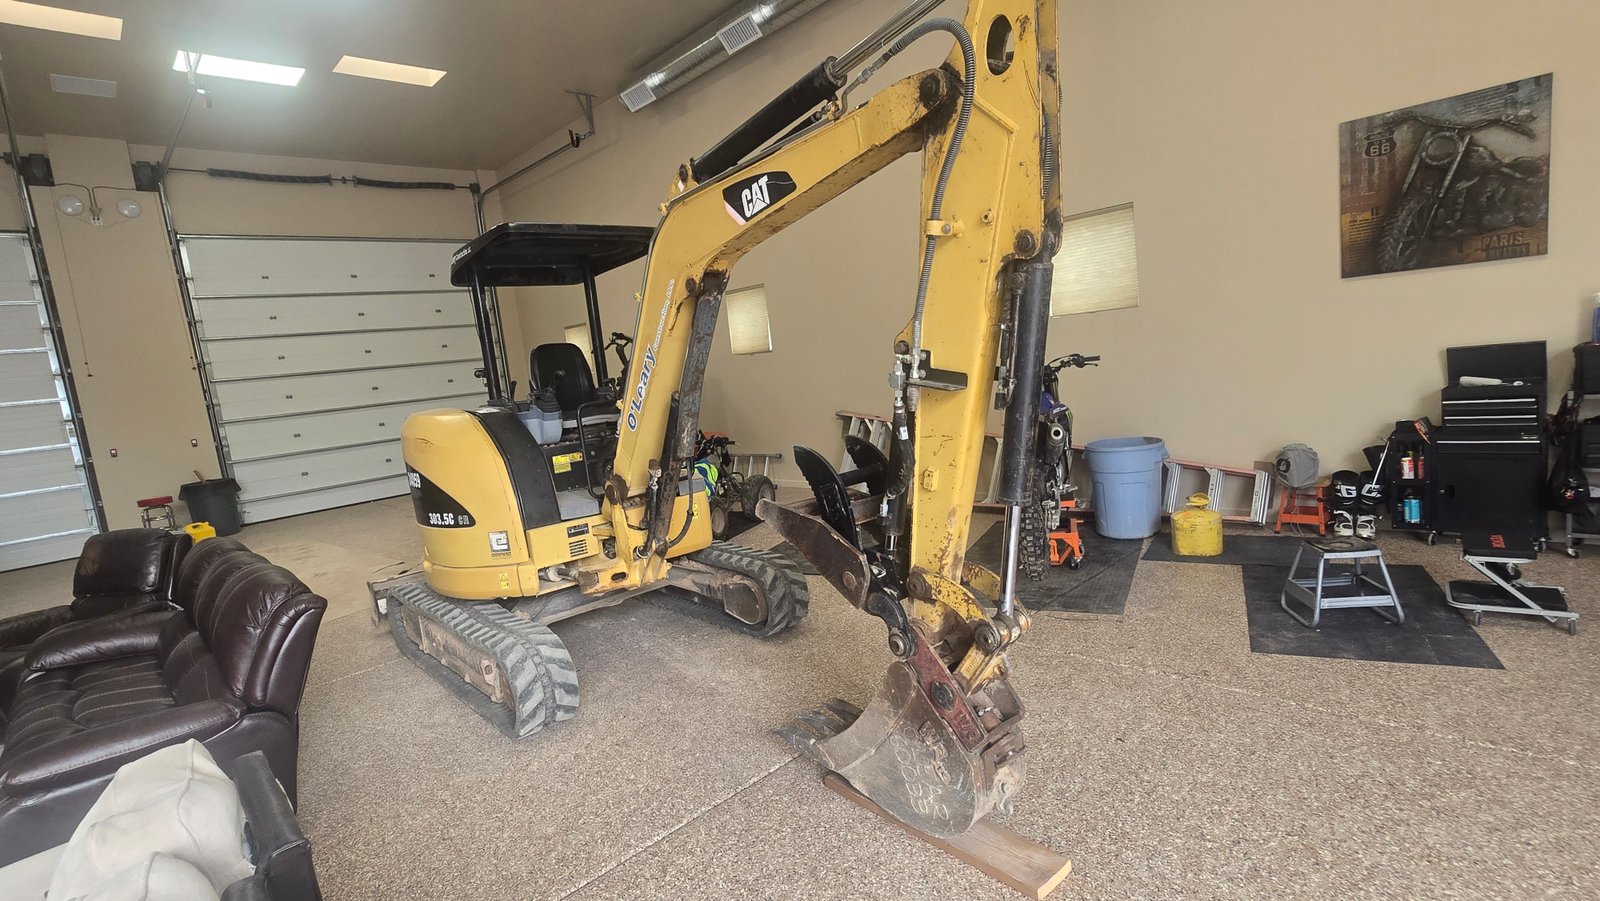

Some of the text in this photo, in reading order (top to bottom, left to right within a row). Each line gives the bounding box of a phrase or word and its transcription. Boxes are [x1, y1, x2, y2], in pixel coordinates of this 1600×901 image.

[1370, 142, 1391, 157] 66
[741, 174, 770, 218] CAT
[1482, 230, 1524, 250] PARIS
[626, 345, 657, 432] O'Leary
[428, 512, 454, 525] 303.5C
